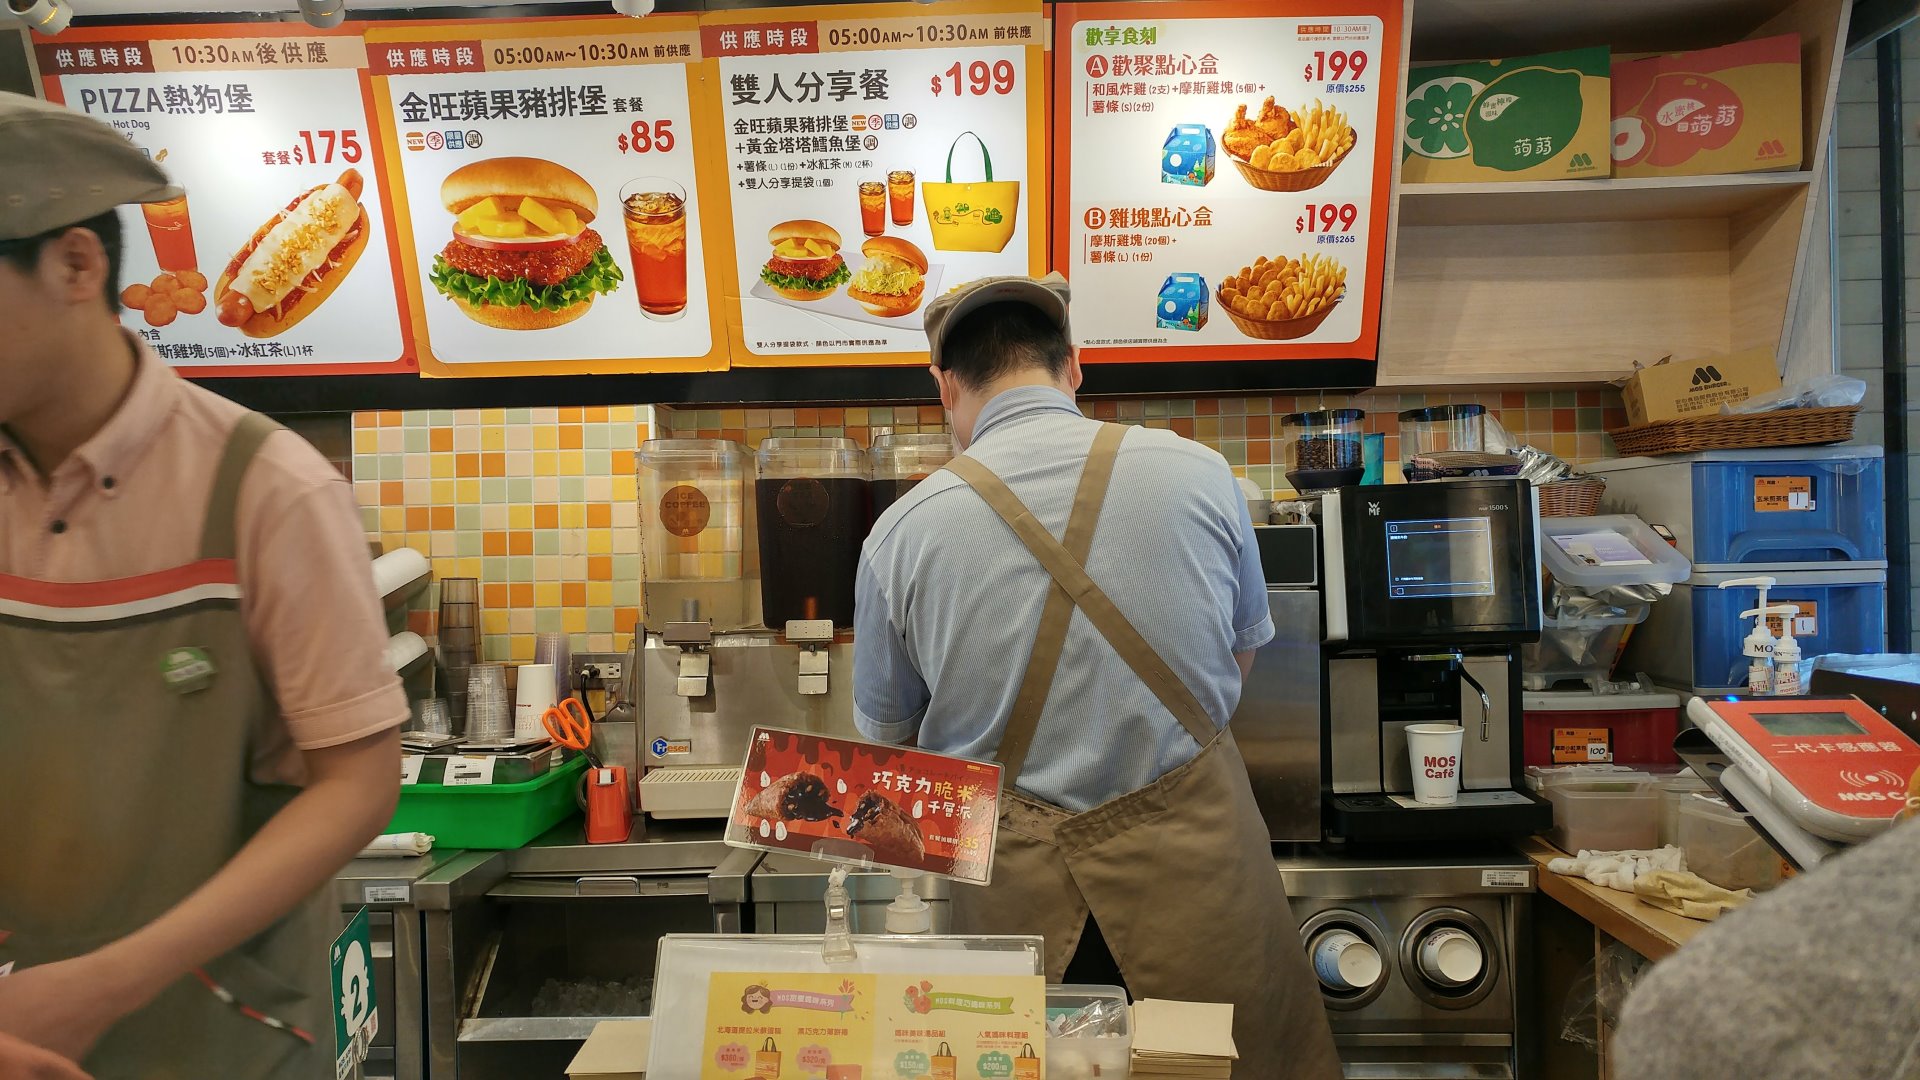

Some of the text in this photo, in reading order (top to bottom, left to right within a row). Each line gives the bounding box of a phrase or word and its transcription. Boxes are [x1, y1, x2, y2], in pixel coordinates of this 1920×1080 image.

[719, 27, 809, 51] 供應時段
[828, 24, 1032, 46] 05:00AM~10:30AM 前供應
[1085, 25, 1157, 46] 歡享食刻
[55, 47, 145, 68] 供應時段
[386, 47, 476, 68] 供應時段
[494, 43, 692, 65] 05:00AM~10:30AM 前供應
[1111, 53, 1219, 77] 歡聚點心盒
[1304, 50, 1368, 83] $199
[730, 68, 889, 106] 雙人分享餐
[930, 59, 1015, 97] $199
[80, 84, 256, 116] PIZZA熱狗堡
[399, 84, 644, 123] 金旺蘋果豬排堡 套餐
[1661, 101, 1696, 124] 水蜜桃
[1689, 104, 1739, 136] 蒟蒻
[113, 119, 130, 129] Hot
[131, 119, 151, 130] Dog
[733, 114, 849, 136] 金旺蘋果豬排堡
[618, 119, 675, 154] $85
[1513, 136, 1553, 157] 蒟蒻
[1109, 206, 1214, 229] 雞塊點心盒
[1295, 203, 1358, 234] $199
[664, 501, 706, 509] COFFEE
[676, 492, 694, 500] ICE
[1424, 755, 1456, 768] MOS
[1425, 768, 1455, 779] Café
[872, 770, 975, 803] 巧克力脆米
[1837, 791, 1887, 802] MOS
[928, 800, 973, 820] 千層派
